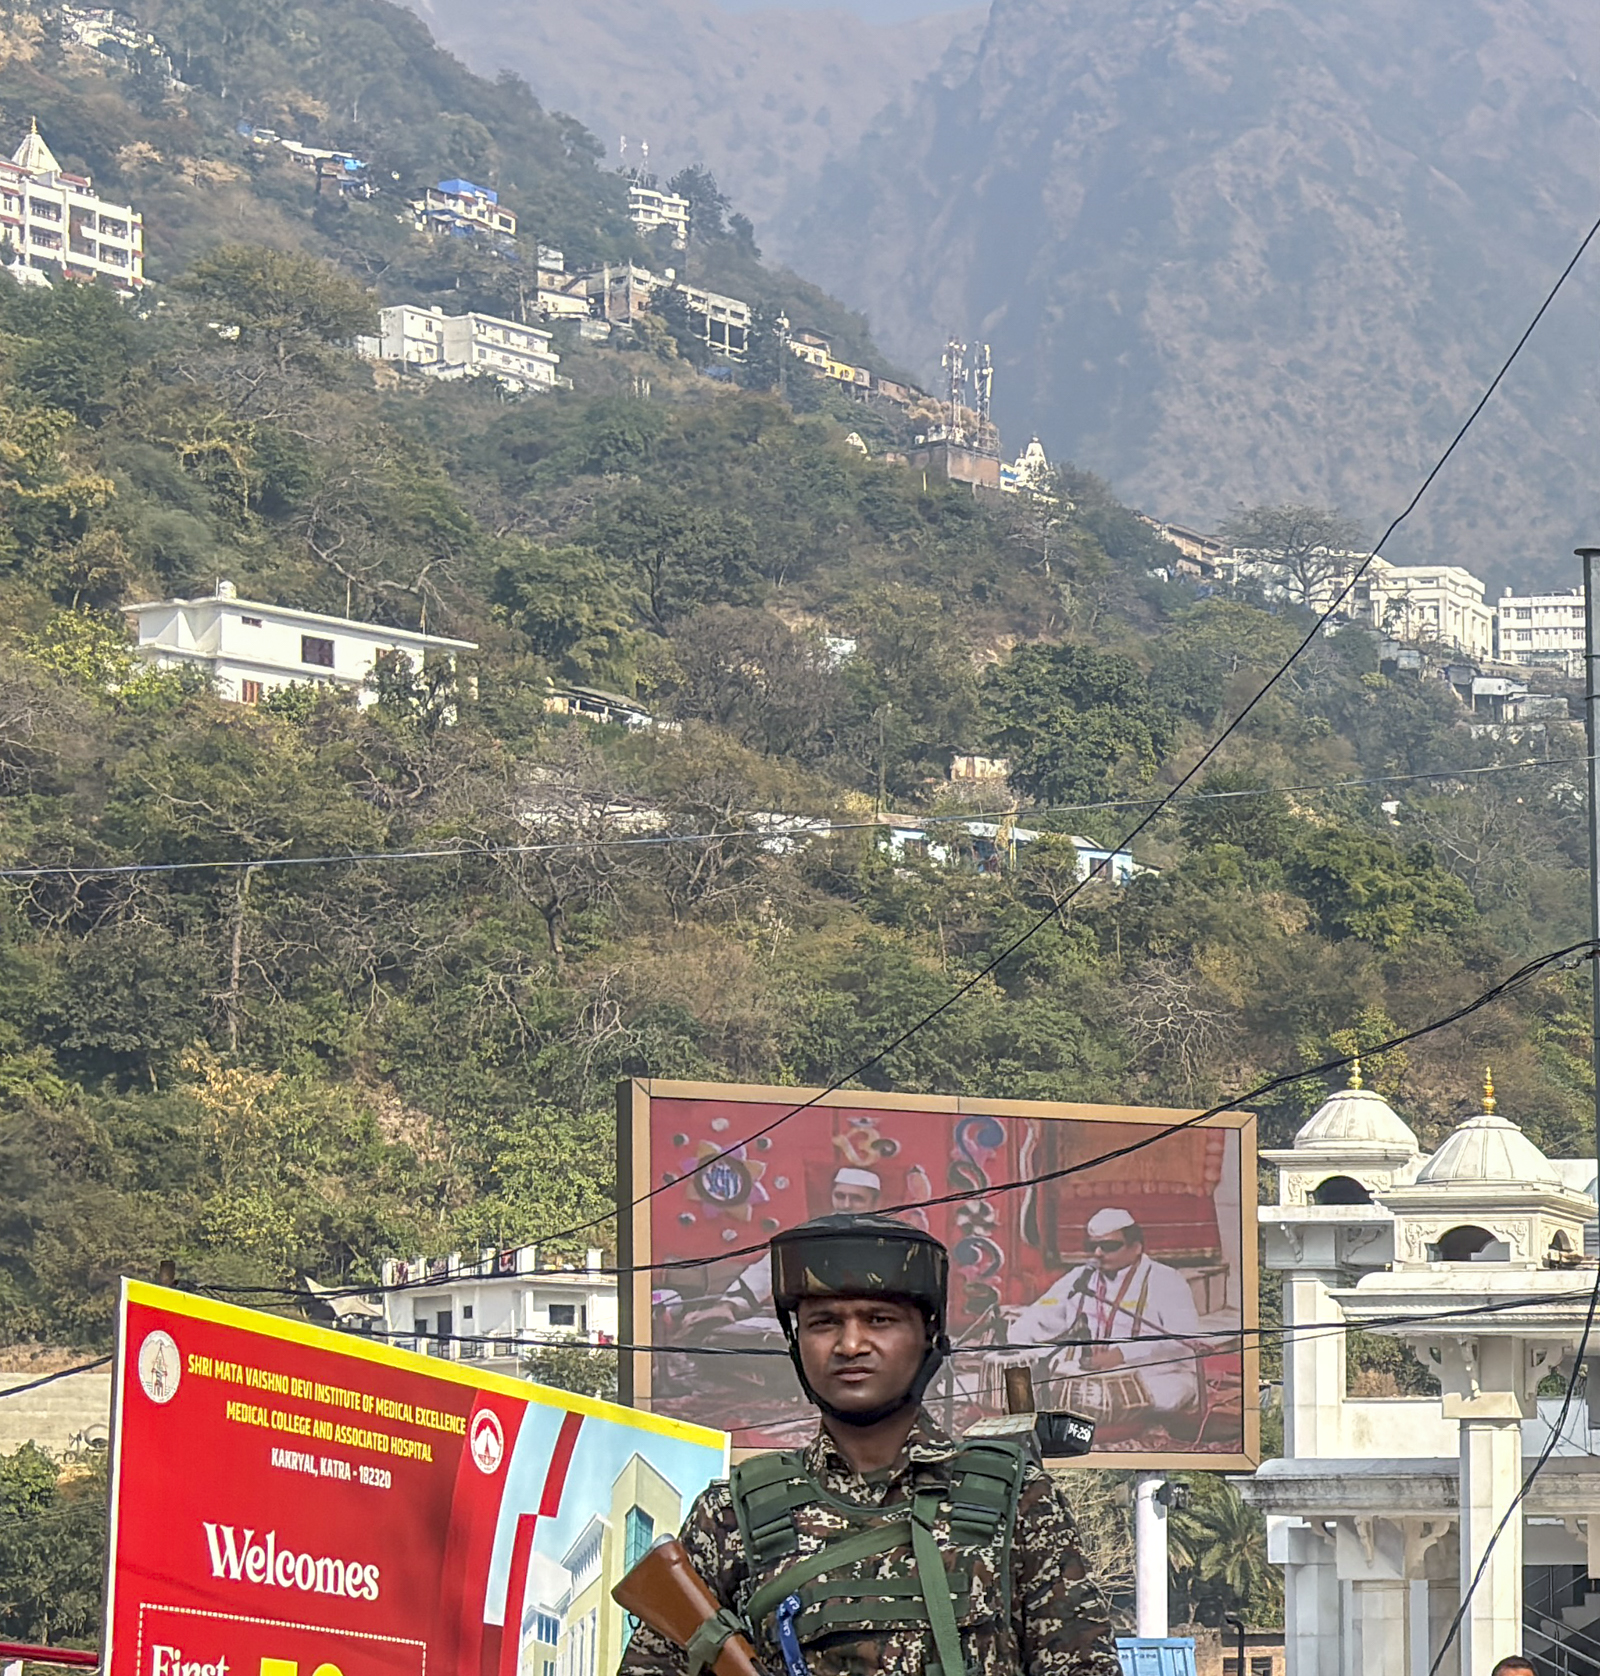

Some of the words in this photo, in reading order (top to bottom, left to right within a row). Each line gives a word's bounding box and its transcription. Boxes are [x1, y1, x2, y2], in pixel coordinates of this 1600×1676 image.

[188, 1353, 213, 1378] SHRI
[214, 1359, 244, 1385] MATA
[245, 1366, 289, 1395] VAISHNO
[291, 1376, 313, 1400] DEVI
[314, 1381, 361, 1411] INSTITUTE
[362, 1394, 374, 1413] OF
[375, 1397, 414, 1424] MEDICAL
[415, 1406, 467, 1436] EXCELLENCE
[226, 1400, 270, 1428] MEDICAL
[271, 1410, 312, 1437] COLLEGE
[312, 1419, 333, 1442] AND
[334, 1423, 389, 1454] ASSOCIATED
[390, 1436, 433, 1463] HOSPITAL
[271, 1447, 319, 1478] KAKRYAL,
[319, 1456, 351, 1481] KATRA
[359, 1464, 392, 1490] 182320
[202, 1521, 380, 1601] Welcomes
